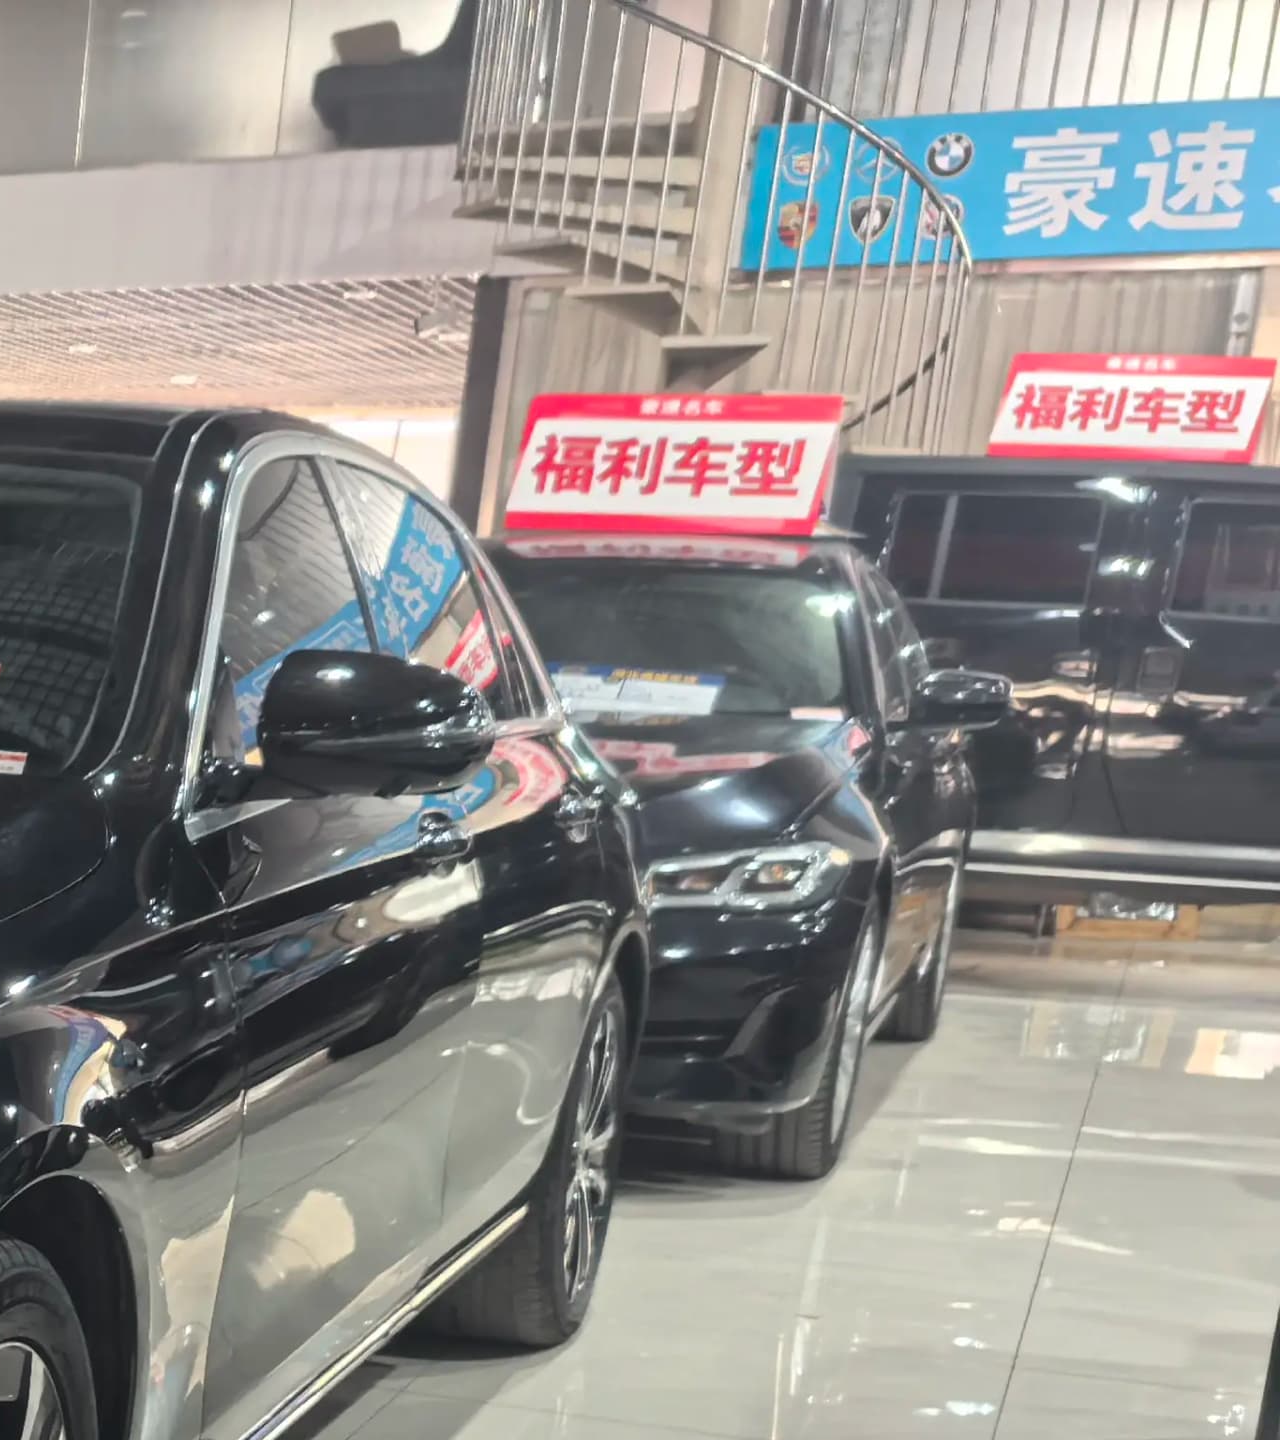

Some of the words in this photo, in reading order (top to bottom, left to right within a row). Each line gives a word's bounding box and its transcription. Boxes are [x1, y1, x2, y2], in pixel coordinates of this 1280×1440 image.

[1002, 121, 1280, 238] 豪速
[1012, 383, 1246, 434] 福利车型
[531, 433, 807, 497] 福利车型
